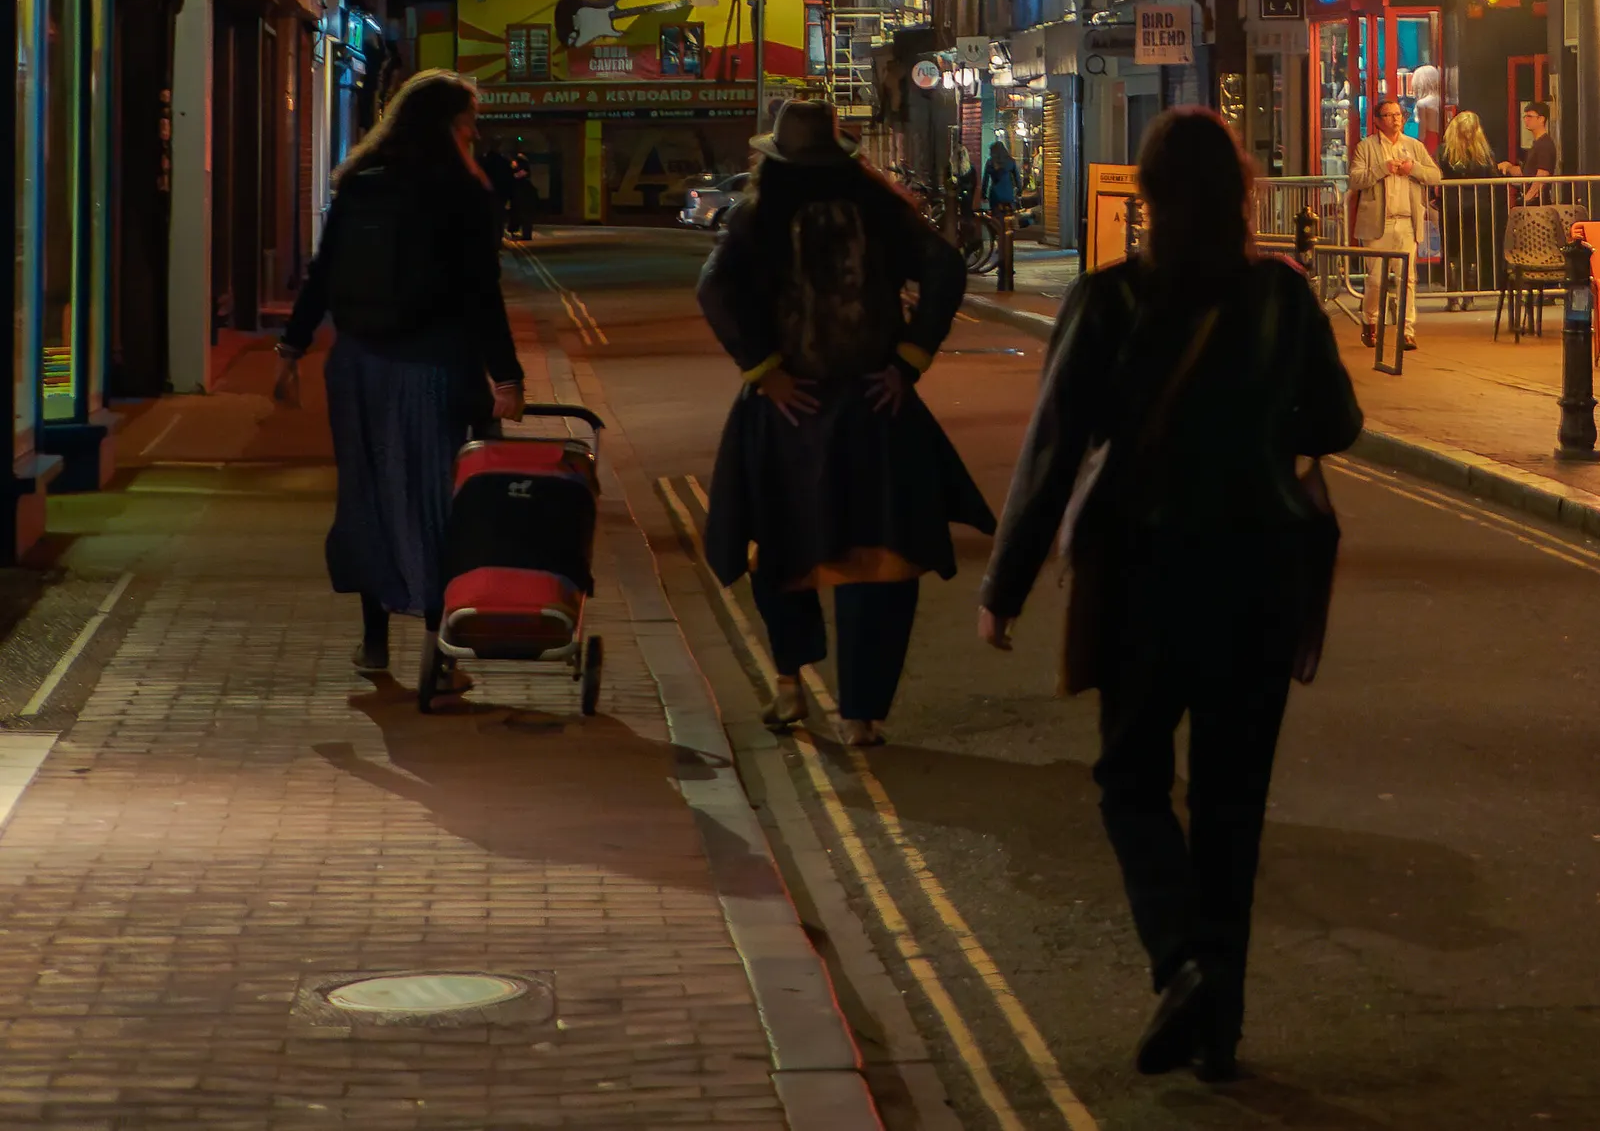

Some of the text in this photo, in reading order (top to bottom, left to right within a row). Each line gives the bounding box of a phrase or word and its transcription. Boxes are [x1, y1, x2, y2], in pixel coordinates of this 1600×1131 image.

[1142, 12, 1174, 29] BIRD
[1142, 29, 1186, 47] BLEND
[589, 58, 633, 71] CAVERN
[542, 90, 580, 104] AMP
[606, 89, 692, 102] KEYBOARD
[698, 88, 756, 101] CENTRE
